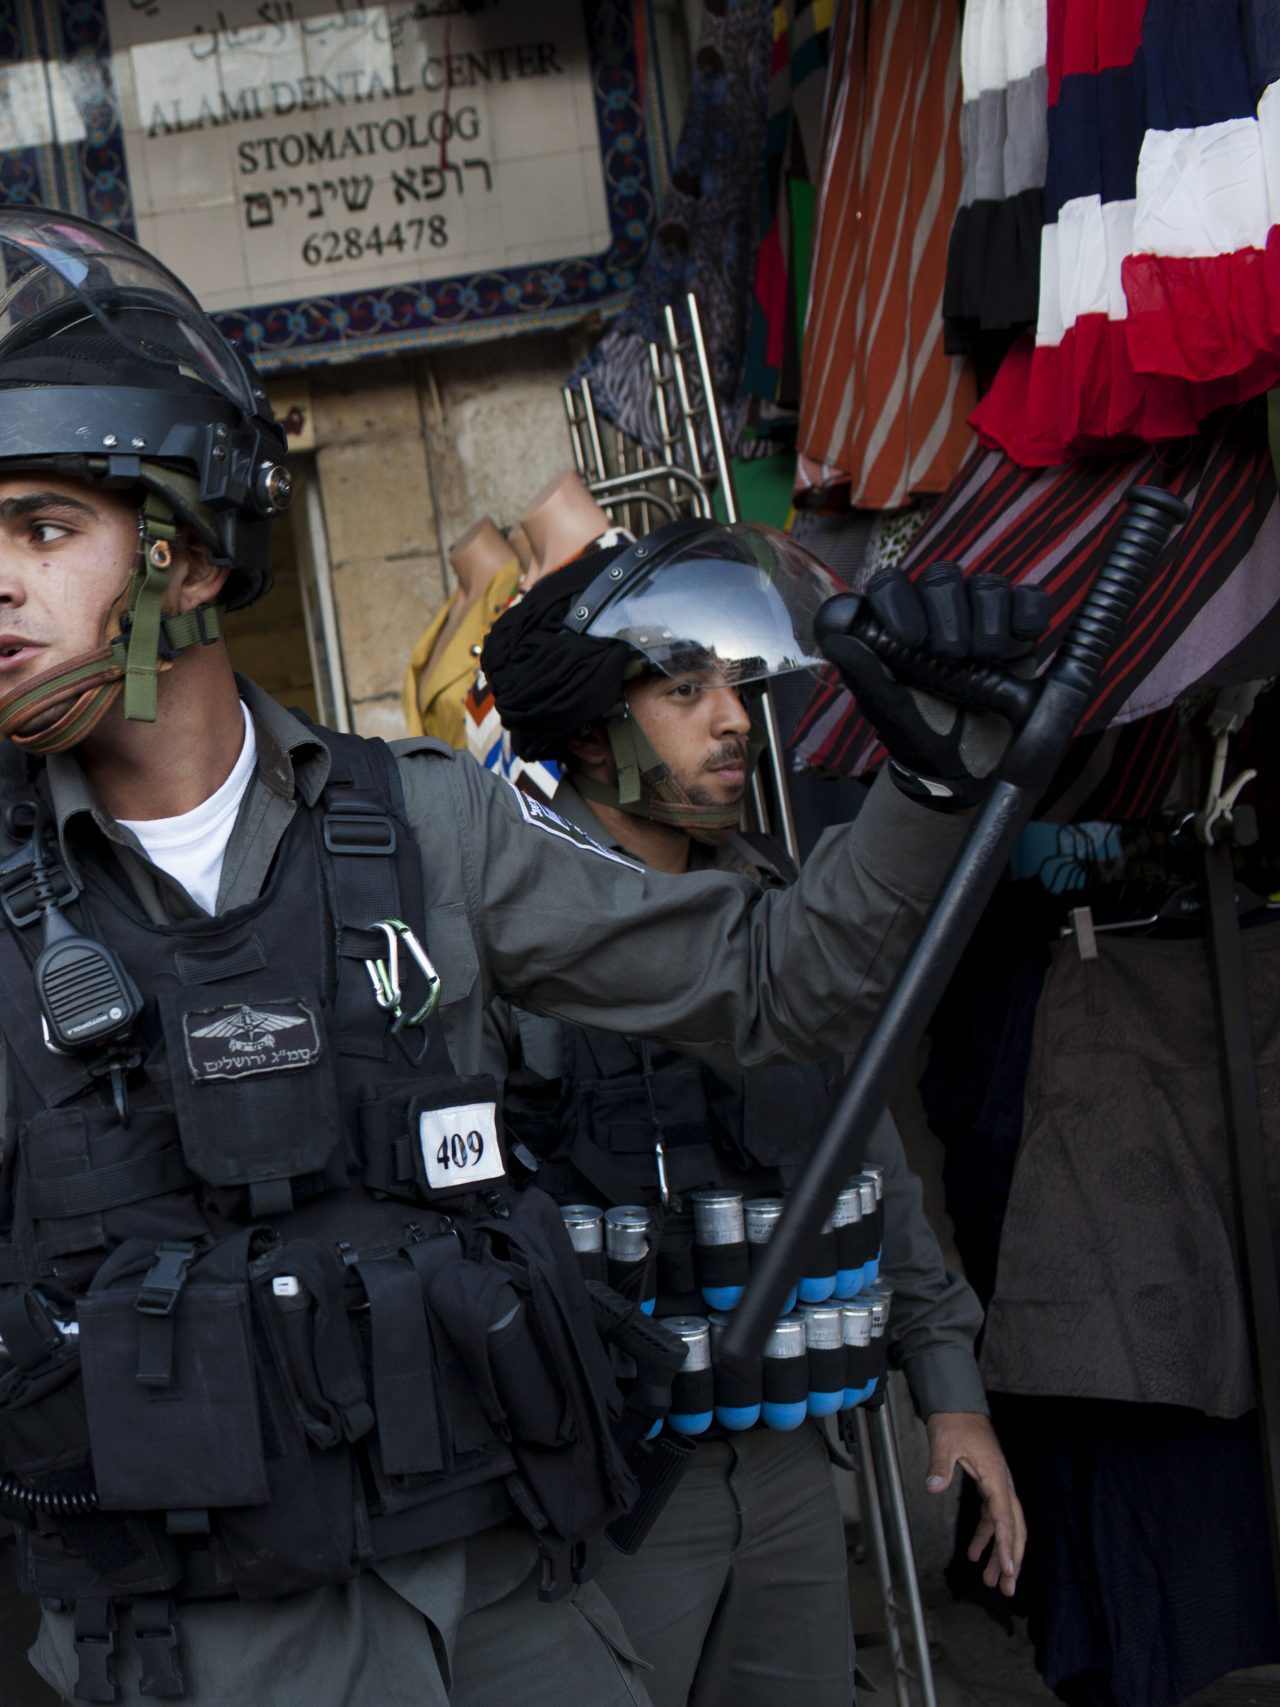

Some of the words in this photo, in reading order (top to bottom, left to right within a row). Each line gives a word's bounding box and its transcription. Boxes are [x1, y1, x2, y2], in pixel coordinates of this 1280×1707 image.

[147, 88, 261, 138] ALAMI
[269, 65, 414, 116] DENTAL
[422, 42, 565, 91] CENTER
[238, 107, 480, 175] STOMATOLOG
[244, 172, 374, 229] שיניים
[390, 158, 494, 205] רופא
[302, 215, 449, 266] 6284478
[203, 1054, 267, 1072] ירושלים
[436, 1130, 484, 1170] 409
